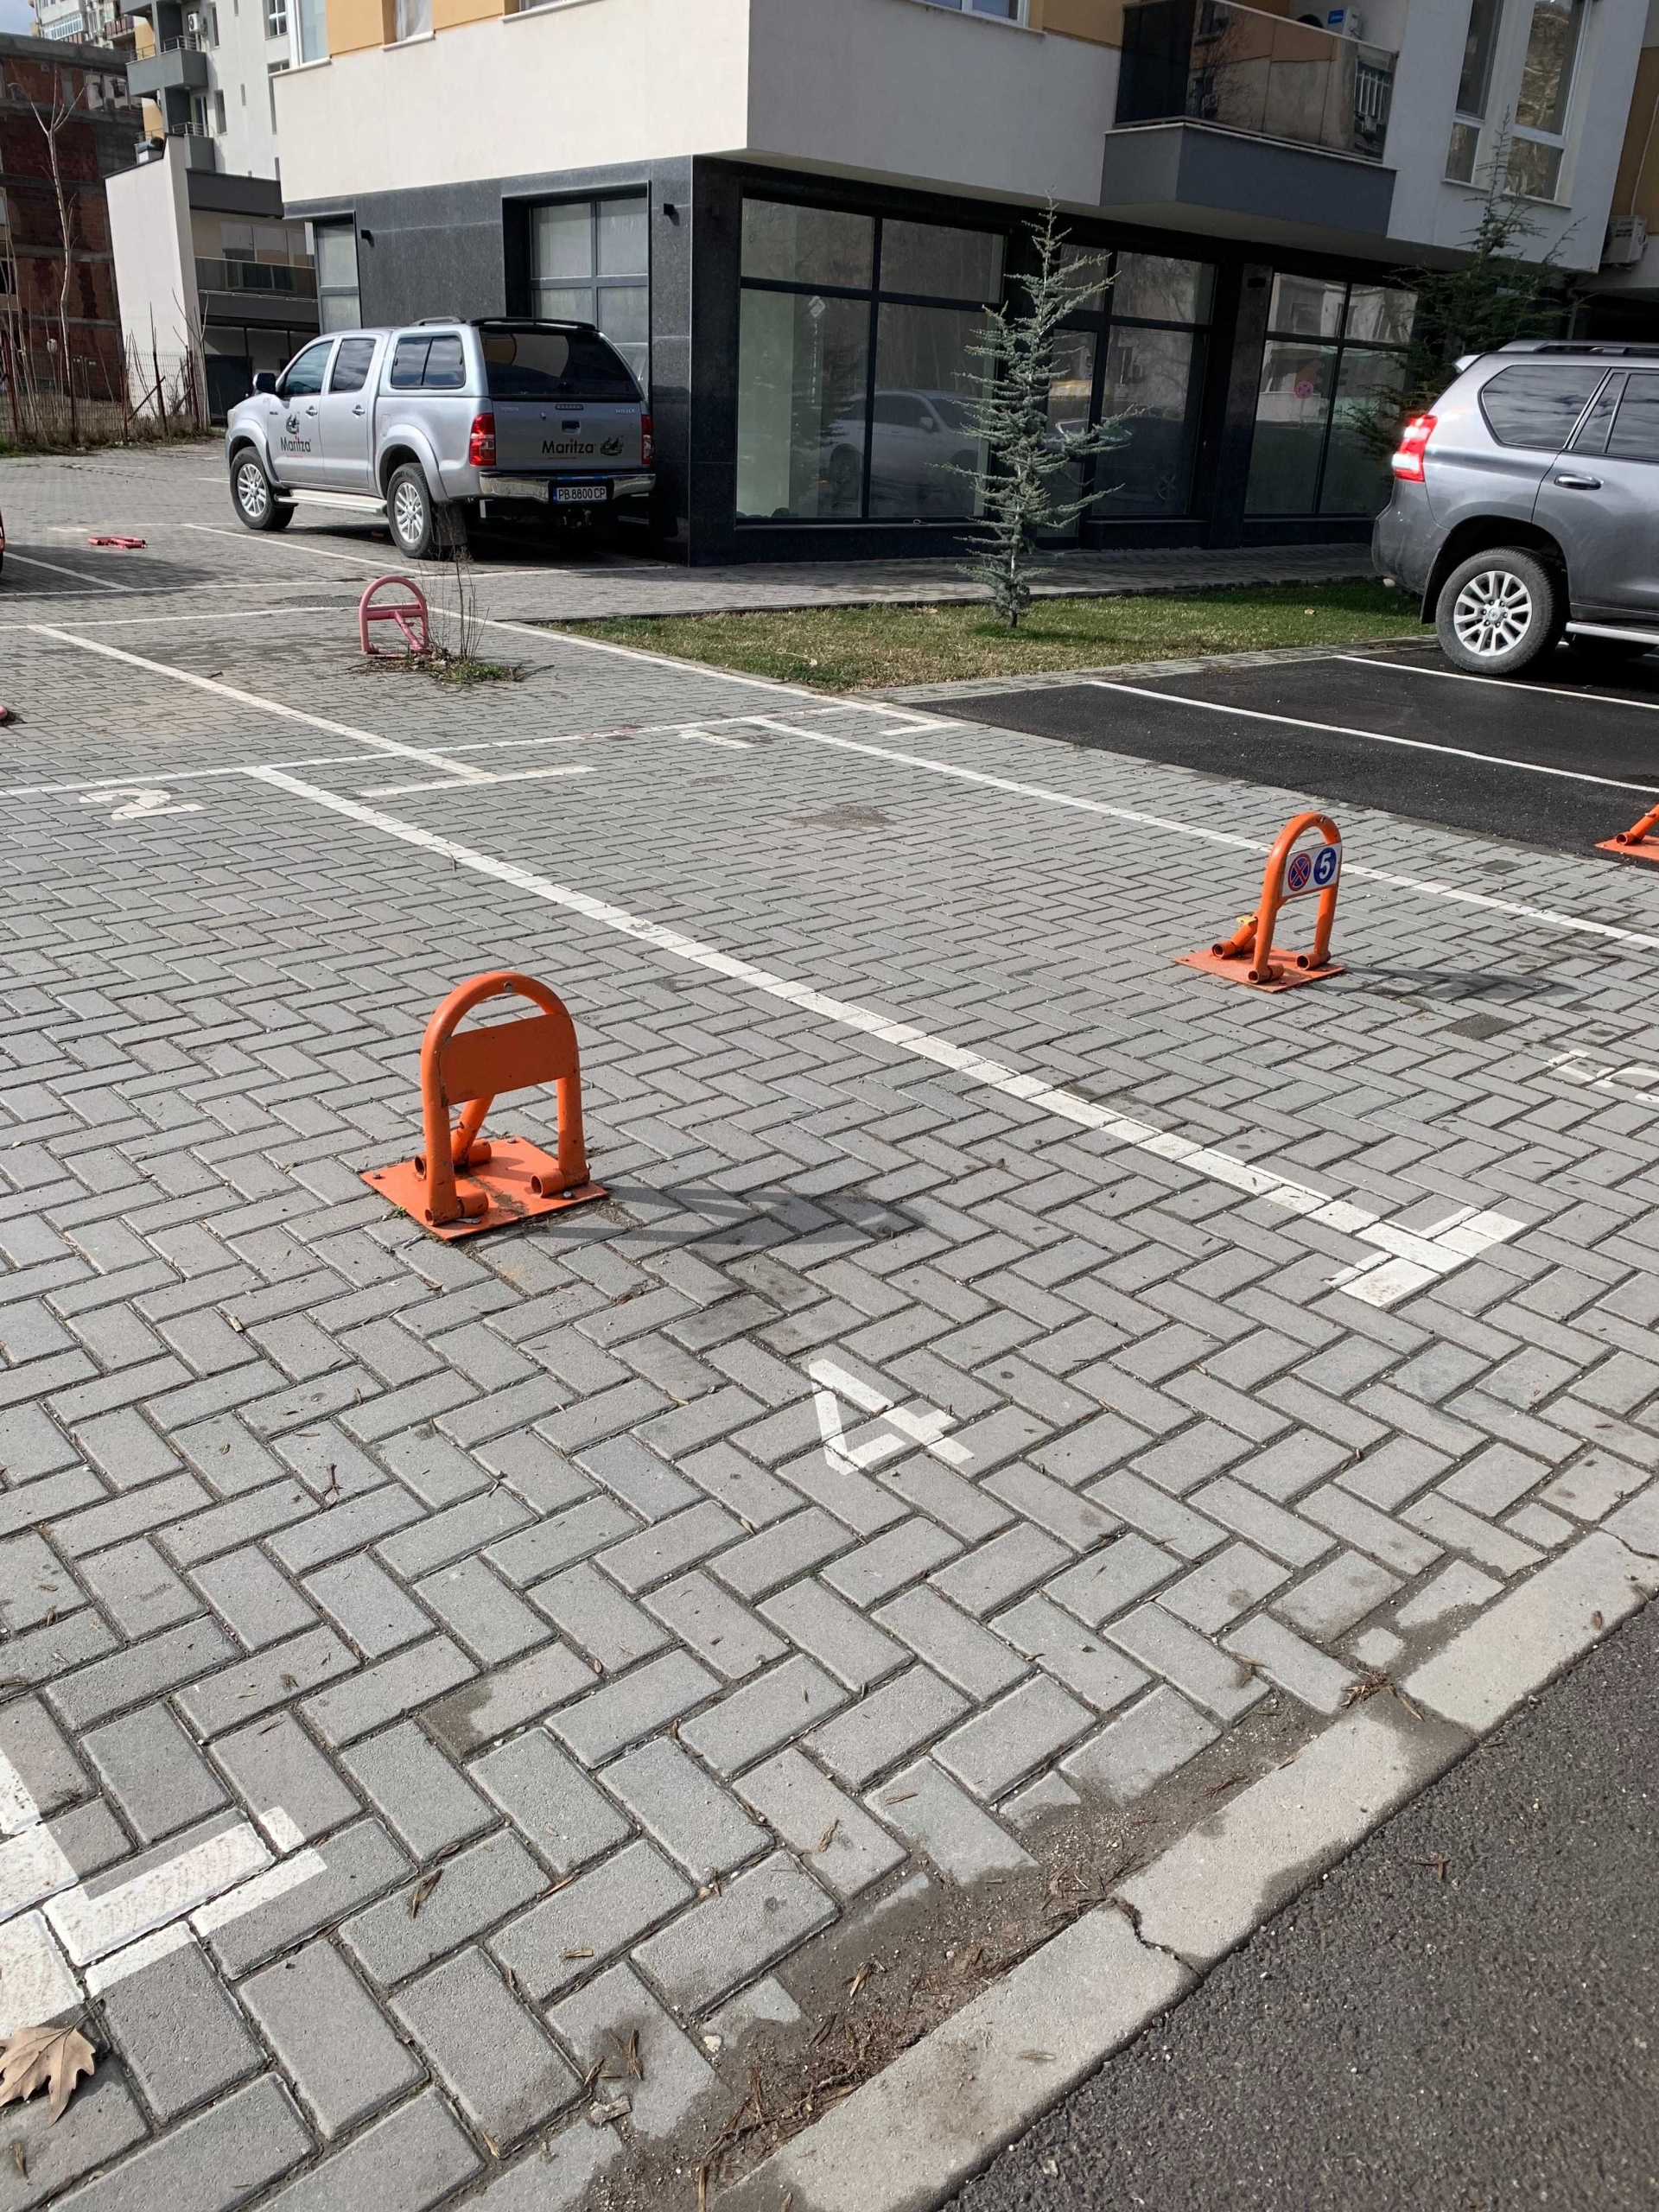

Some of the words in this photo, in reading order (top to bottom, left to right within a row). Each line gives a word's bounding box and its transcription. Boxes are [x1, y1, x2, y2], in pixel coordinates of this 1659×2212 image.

[280, 435, 311, 453] Maritza
[542, 438, 594, 454] Maritza
[79, 787, 206, 821] 2
[1319, 852, 1332, 880] 5
[809, 1359, 975, 1476] 4
